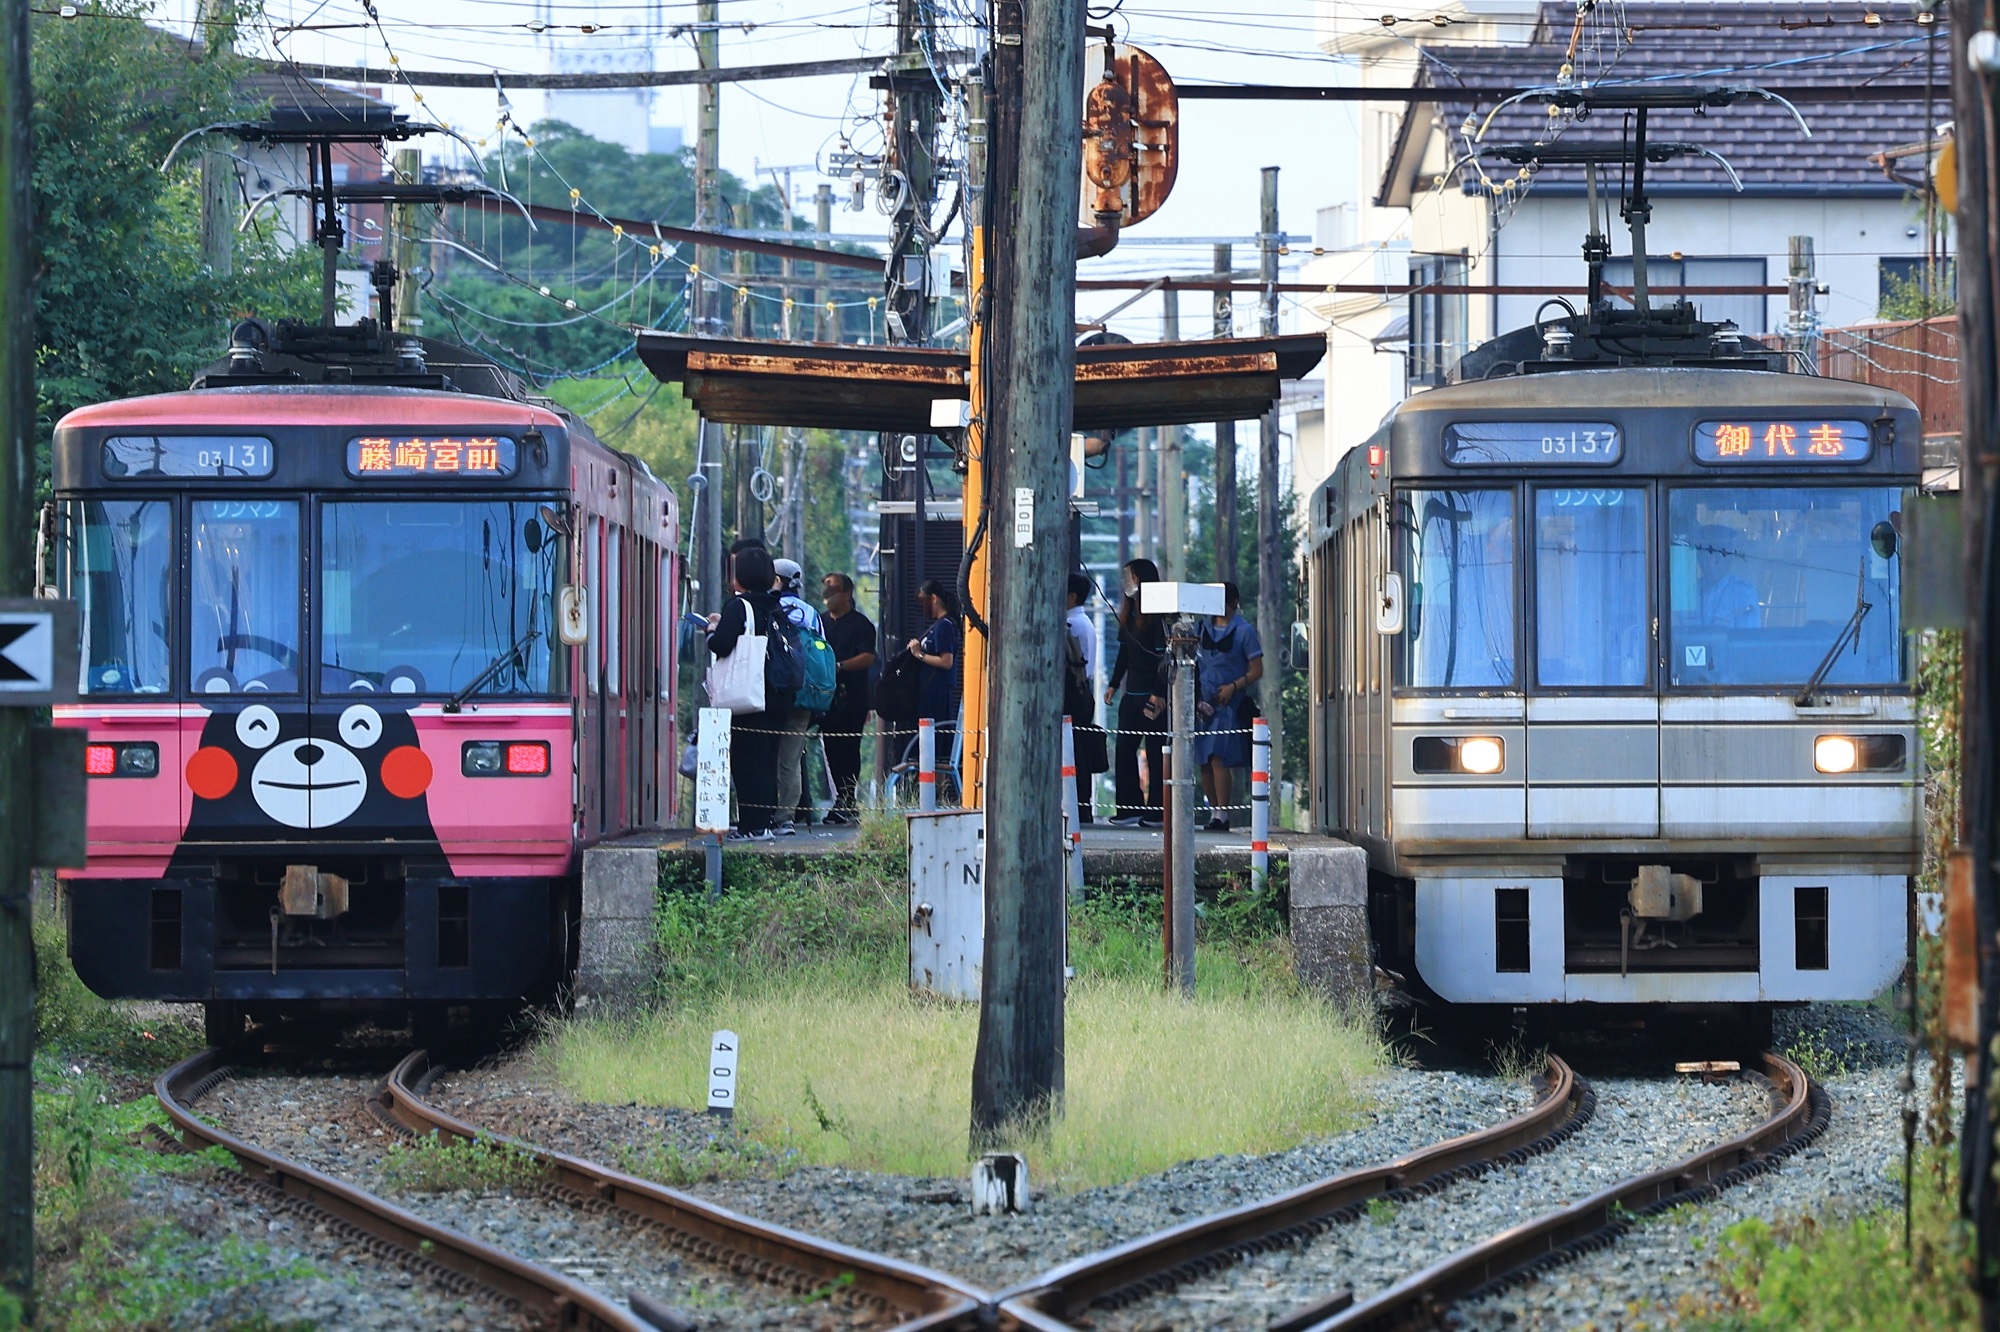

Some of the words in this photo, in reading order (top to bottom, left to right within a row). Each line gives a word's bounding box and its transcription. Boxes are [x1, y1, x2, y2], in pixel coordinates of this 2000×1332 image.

[358, 438, 498, 470] 藤崎宮前
[1541, 431, 1615, 454] 03137
[1715, 423, 1843, 456] 御代志
[198, 445, 268, 467] 03131
[711, 1042, 733, 1098] 400
